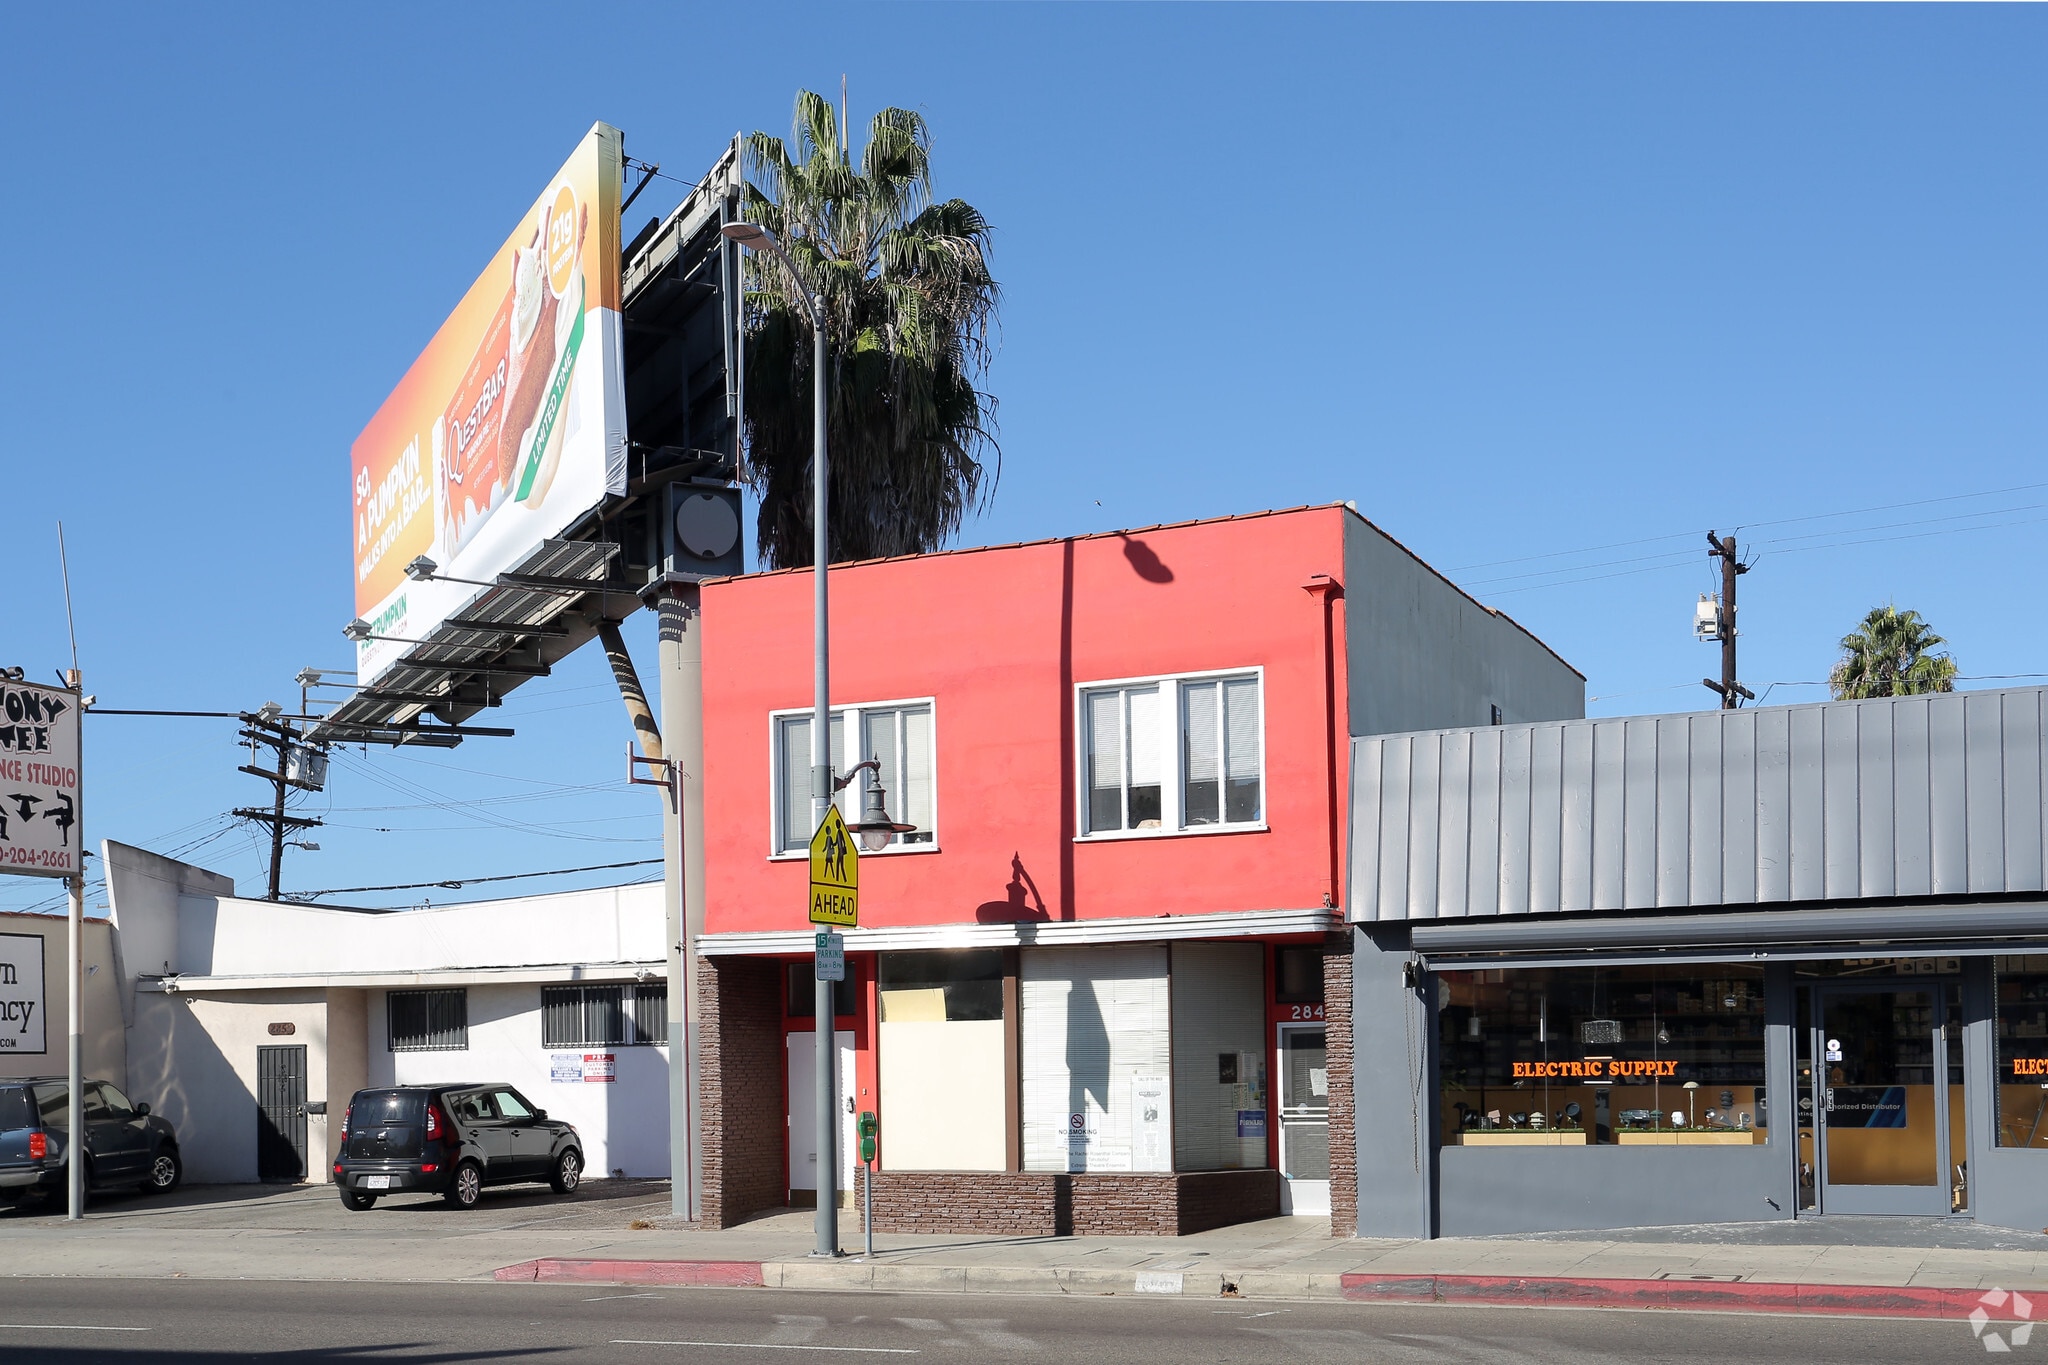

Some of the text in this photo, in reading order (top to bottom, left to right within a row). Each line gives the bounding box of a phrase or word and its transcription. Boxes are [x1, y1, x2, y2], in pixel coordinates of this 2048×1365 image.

[552, 208, 573, 255] 21g
[552, 243, 574, 277] PROTEIN
[532, 347, 573, 465] LIMITED TIME
[356, 465, 371, 506] SO,
[358, 432, 420, 554] A PUMPKIN
[358, 540, 380, 584] WALKS
[380, 519, 395, 559] INTO
[396, 511, 402, 537] A
[27, 762, 76, 788] STUDIO
[813, 893, 855, 916] AHEAD
[817, 935, 826, 946] 15
[817, 949, 842, 959] PARKING
[1291, 1005, 1324, 1019] 284
[1512, 1060, 1678, 1077] ELECTRIC SUPPLY
